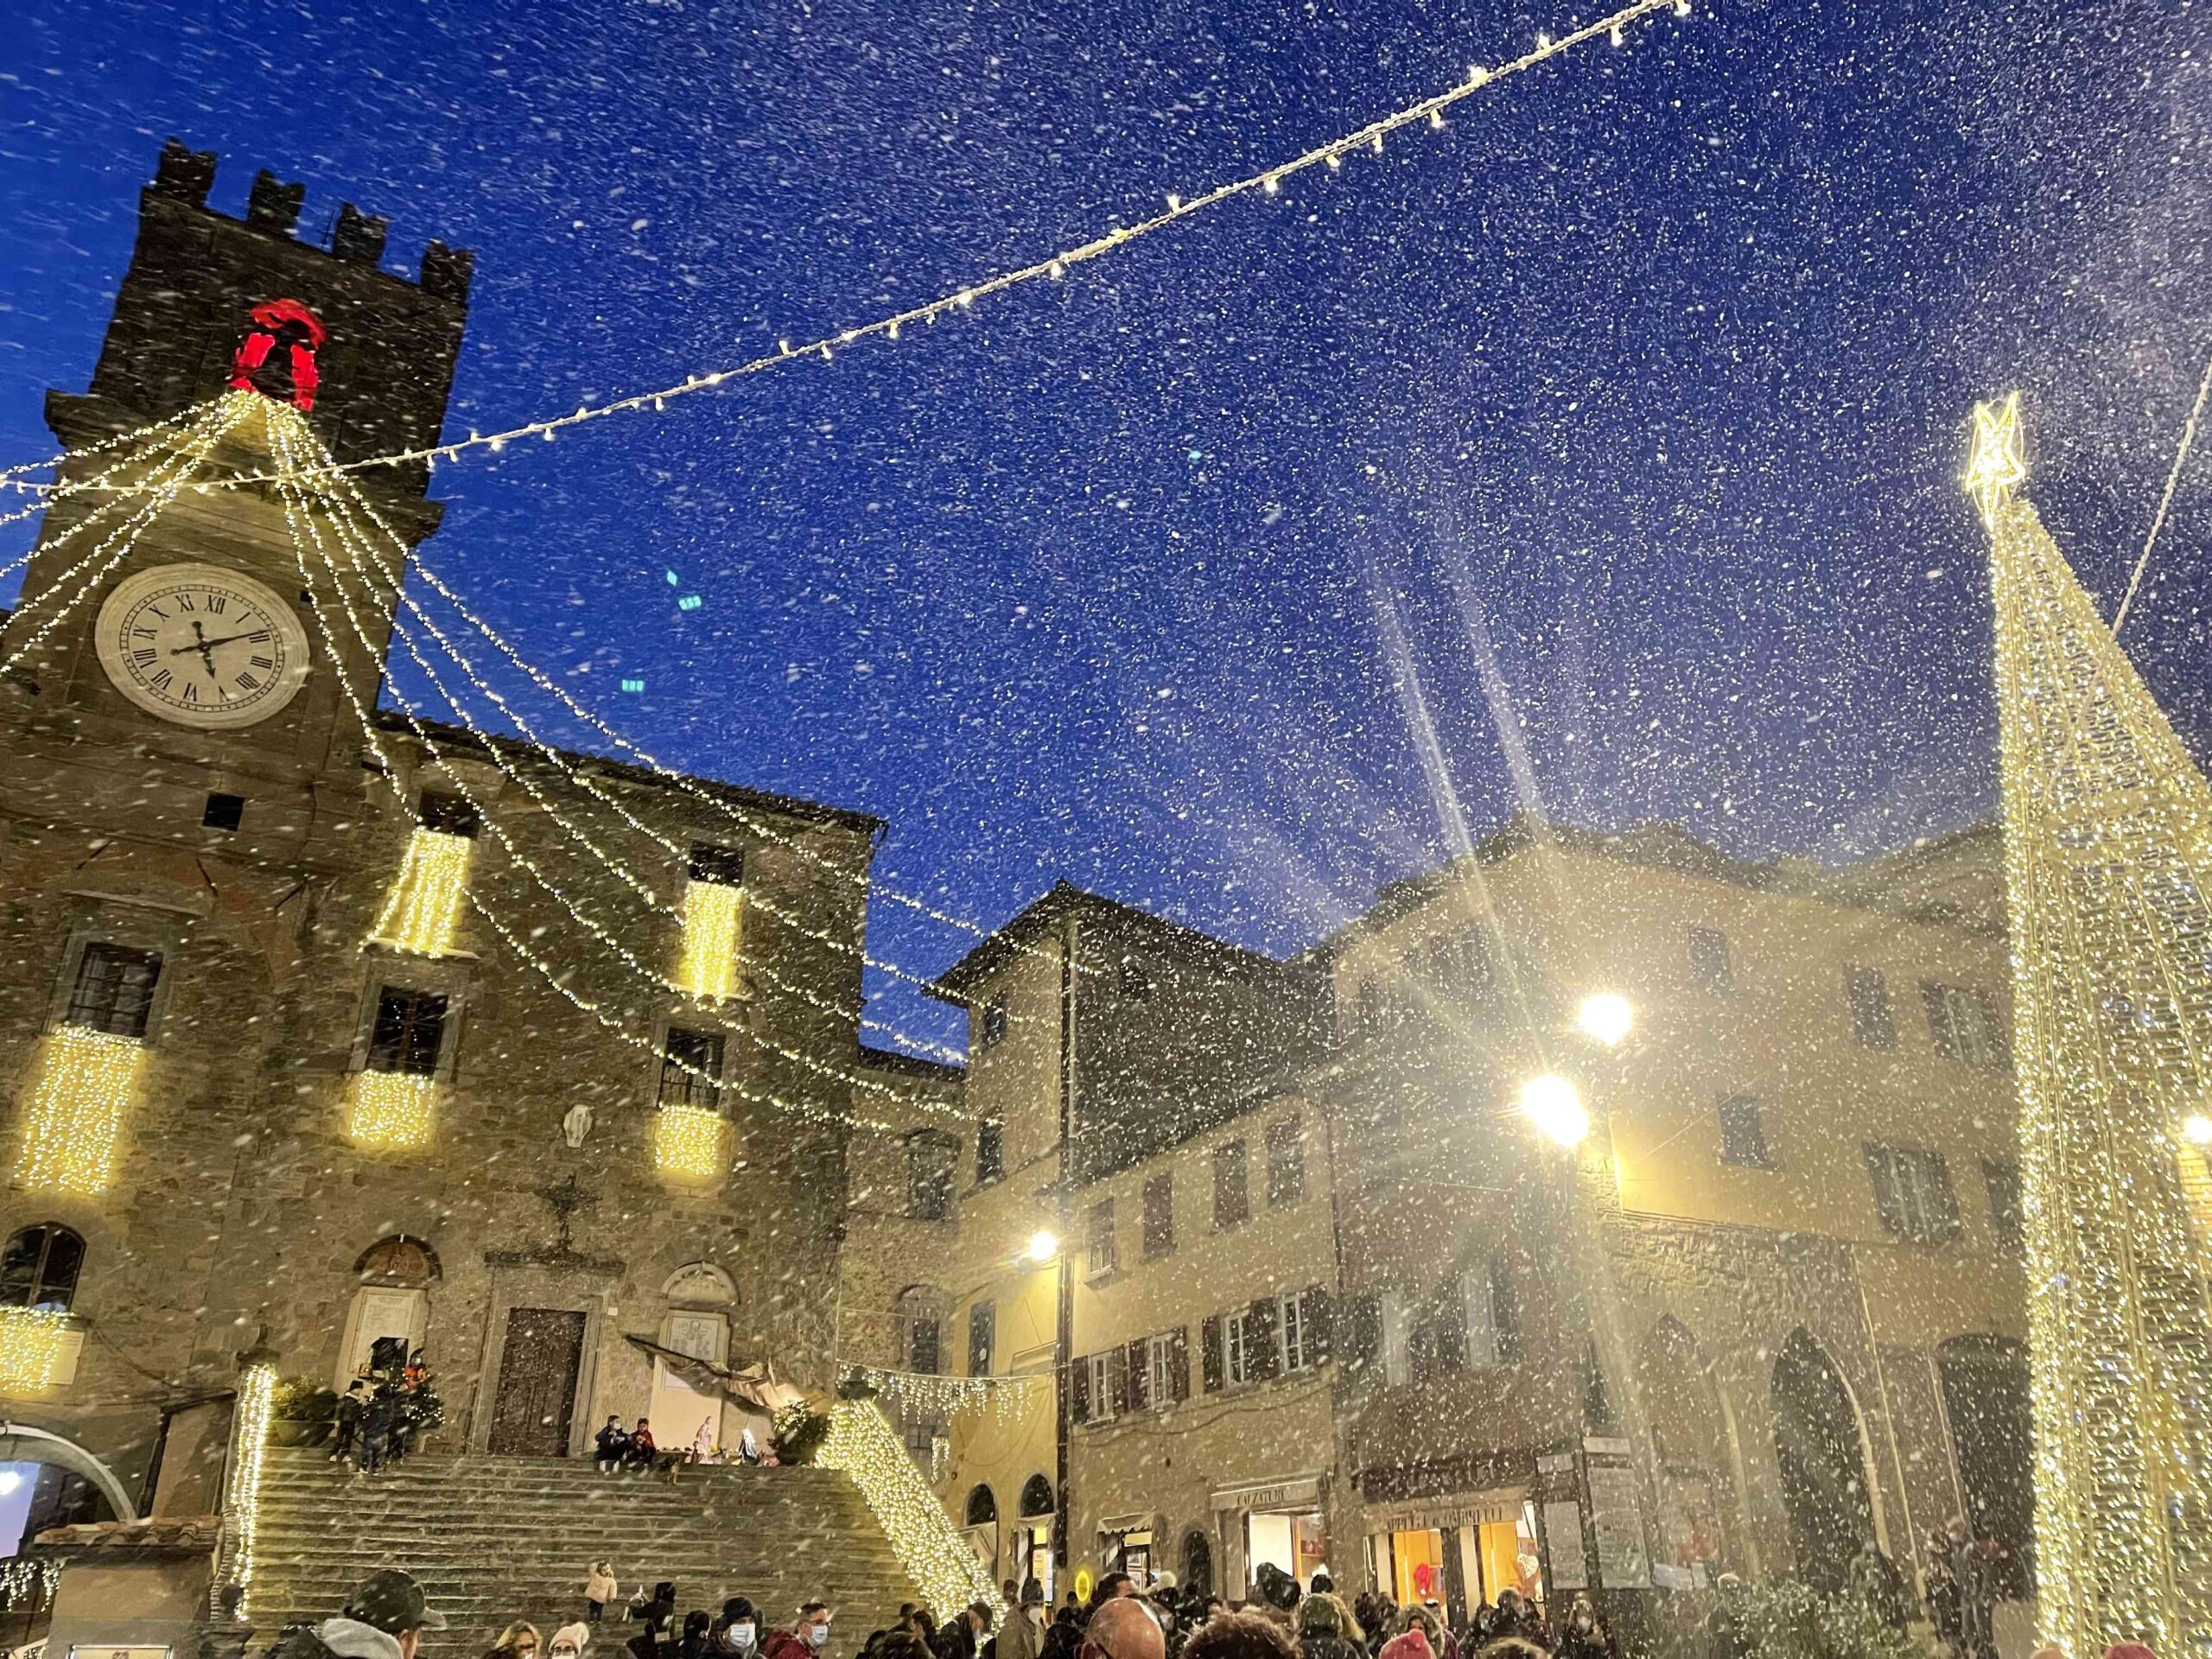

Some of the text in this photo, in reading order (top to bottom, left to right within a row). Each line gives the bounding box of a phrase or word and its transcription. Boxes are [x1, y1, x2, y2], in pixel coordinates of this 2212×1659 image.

[149, 604, 170, 622] X
[175, 594, 195, 613] XI
[205, 594, 226, 614] XII
[250, 655, 273, 670] III
[182, 683, 198, 702] VI
